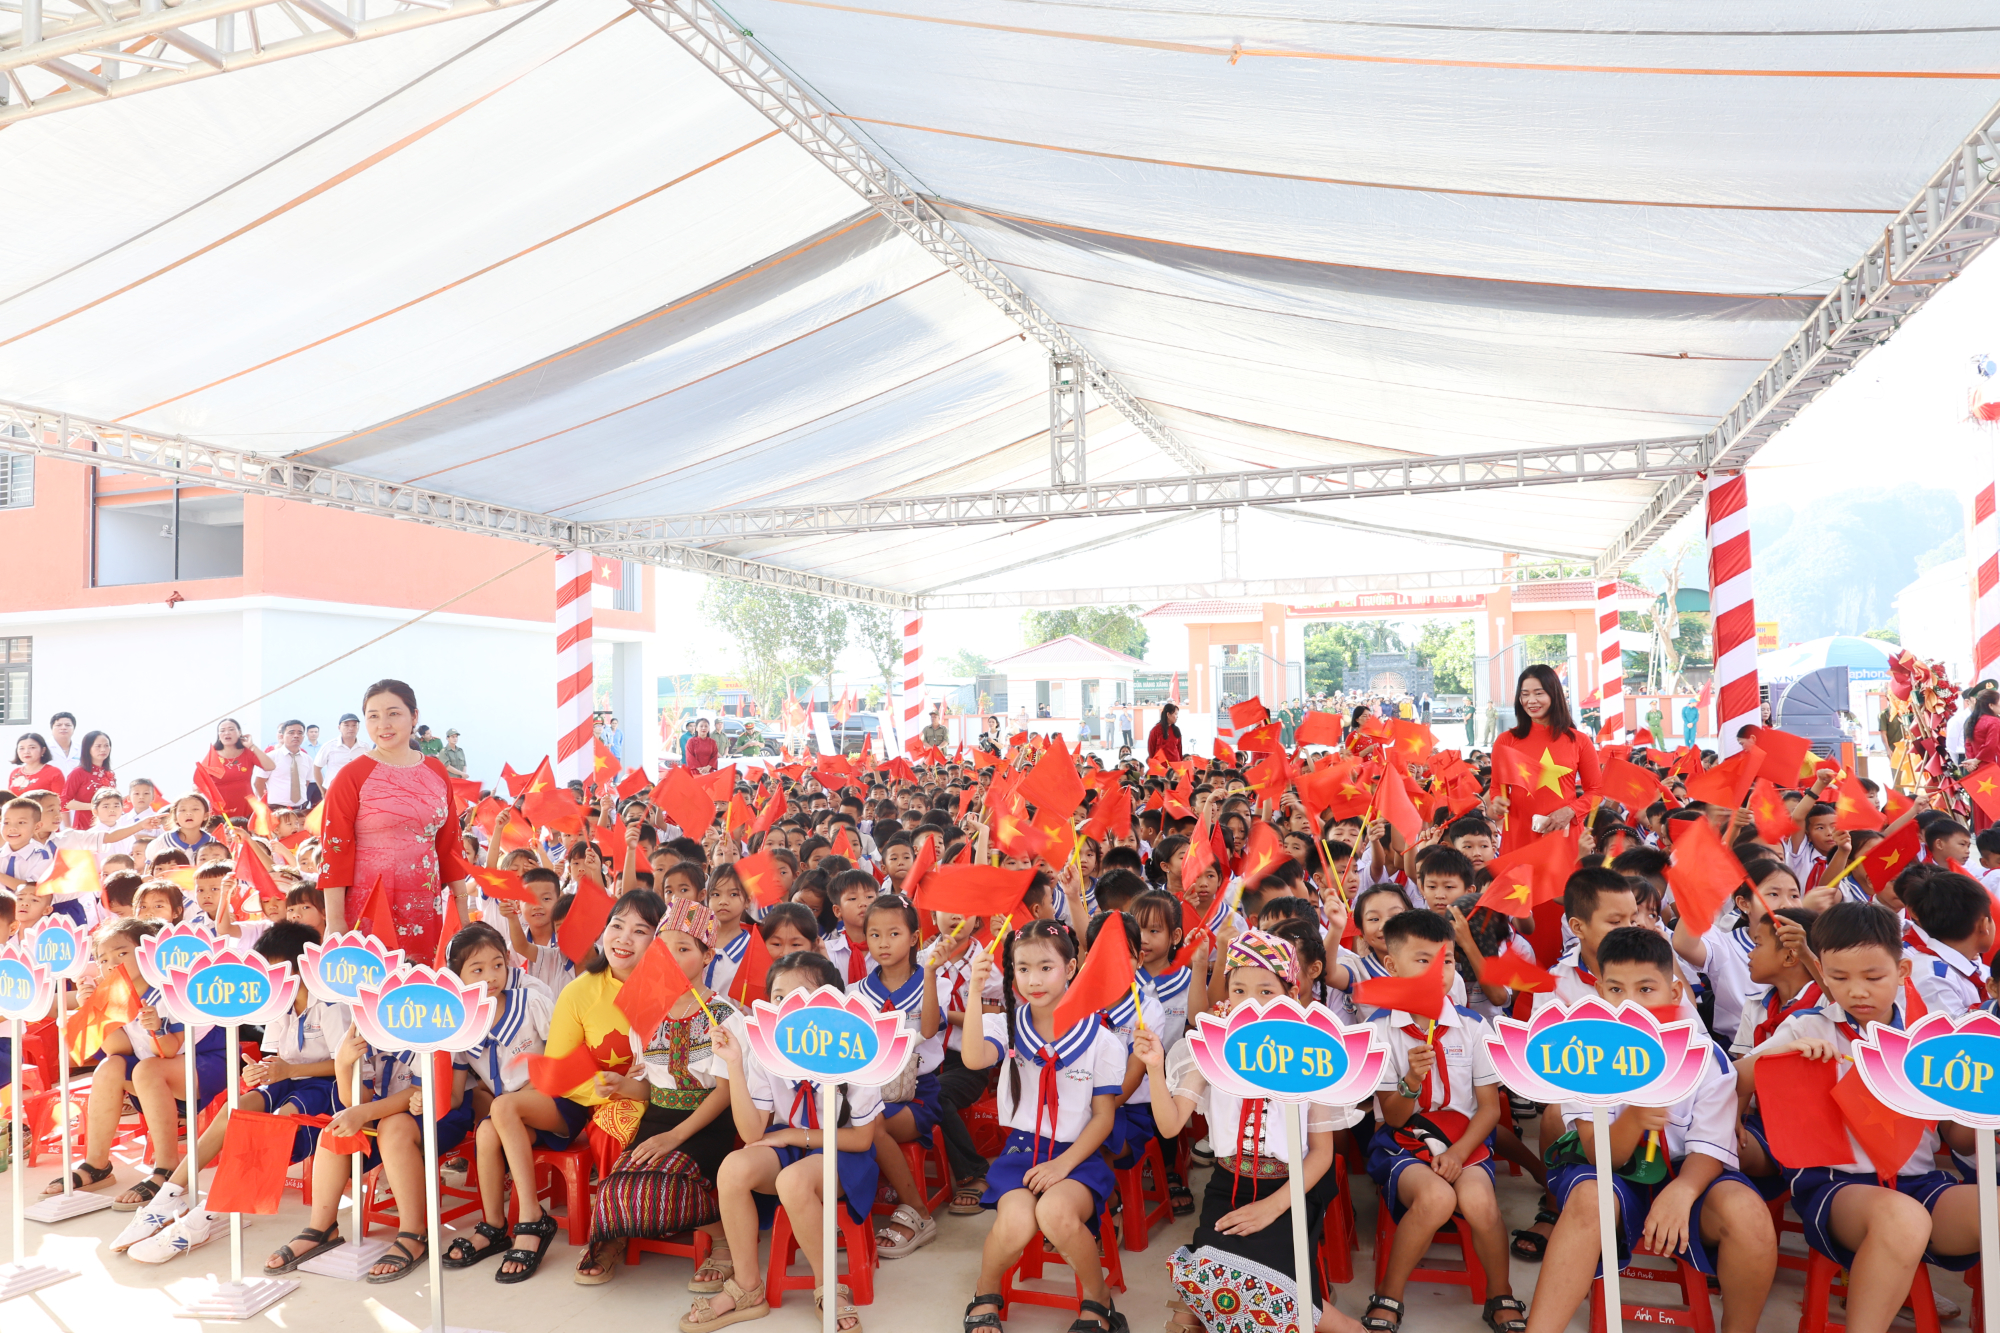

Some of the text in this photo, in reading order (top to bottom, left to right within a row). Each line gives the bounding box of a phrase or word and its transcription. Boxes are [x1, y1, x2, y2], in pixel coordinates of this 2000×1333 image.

[1359, 593, 1394, 606] TRƯỜNG
[38, 937, 72, 962] LỚP 3A
[161, 946, 190, 971] LỚP
[0, 969, 31, 1000] ỚP 3D
[326, 957, 379, 987] LỚP 3C
[196, 976, 262, 1005] LỚP 3E
[387, 997, 456, 1029] LỚP 4A
[785, 1021, 867, 1060] LỚP 5A
[1540, 1035, 1650, 1076] LỚP 4D
[1237, 1035, 1334, 1077] LỚP 5B
[1920, 1050, 1994, 1093] LỚP
[1659, 1311, 1674, 1324] Em
